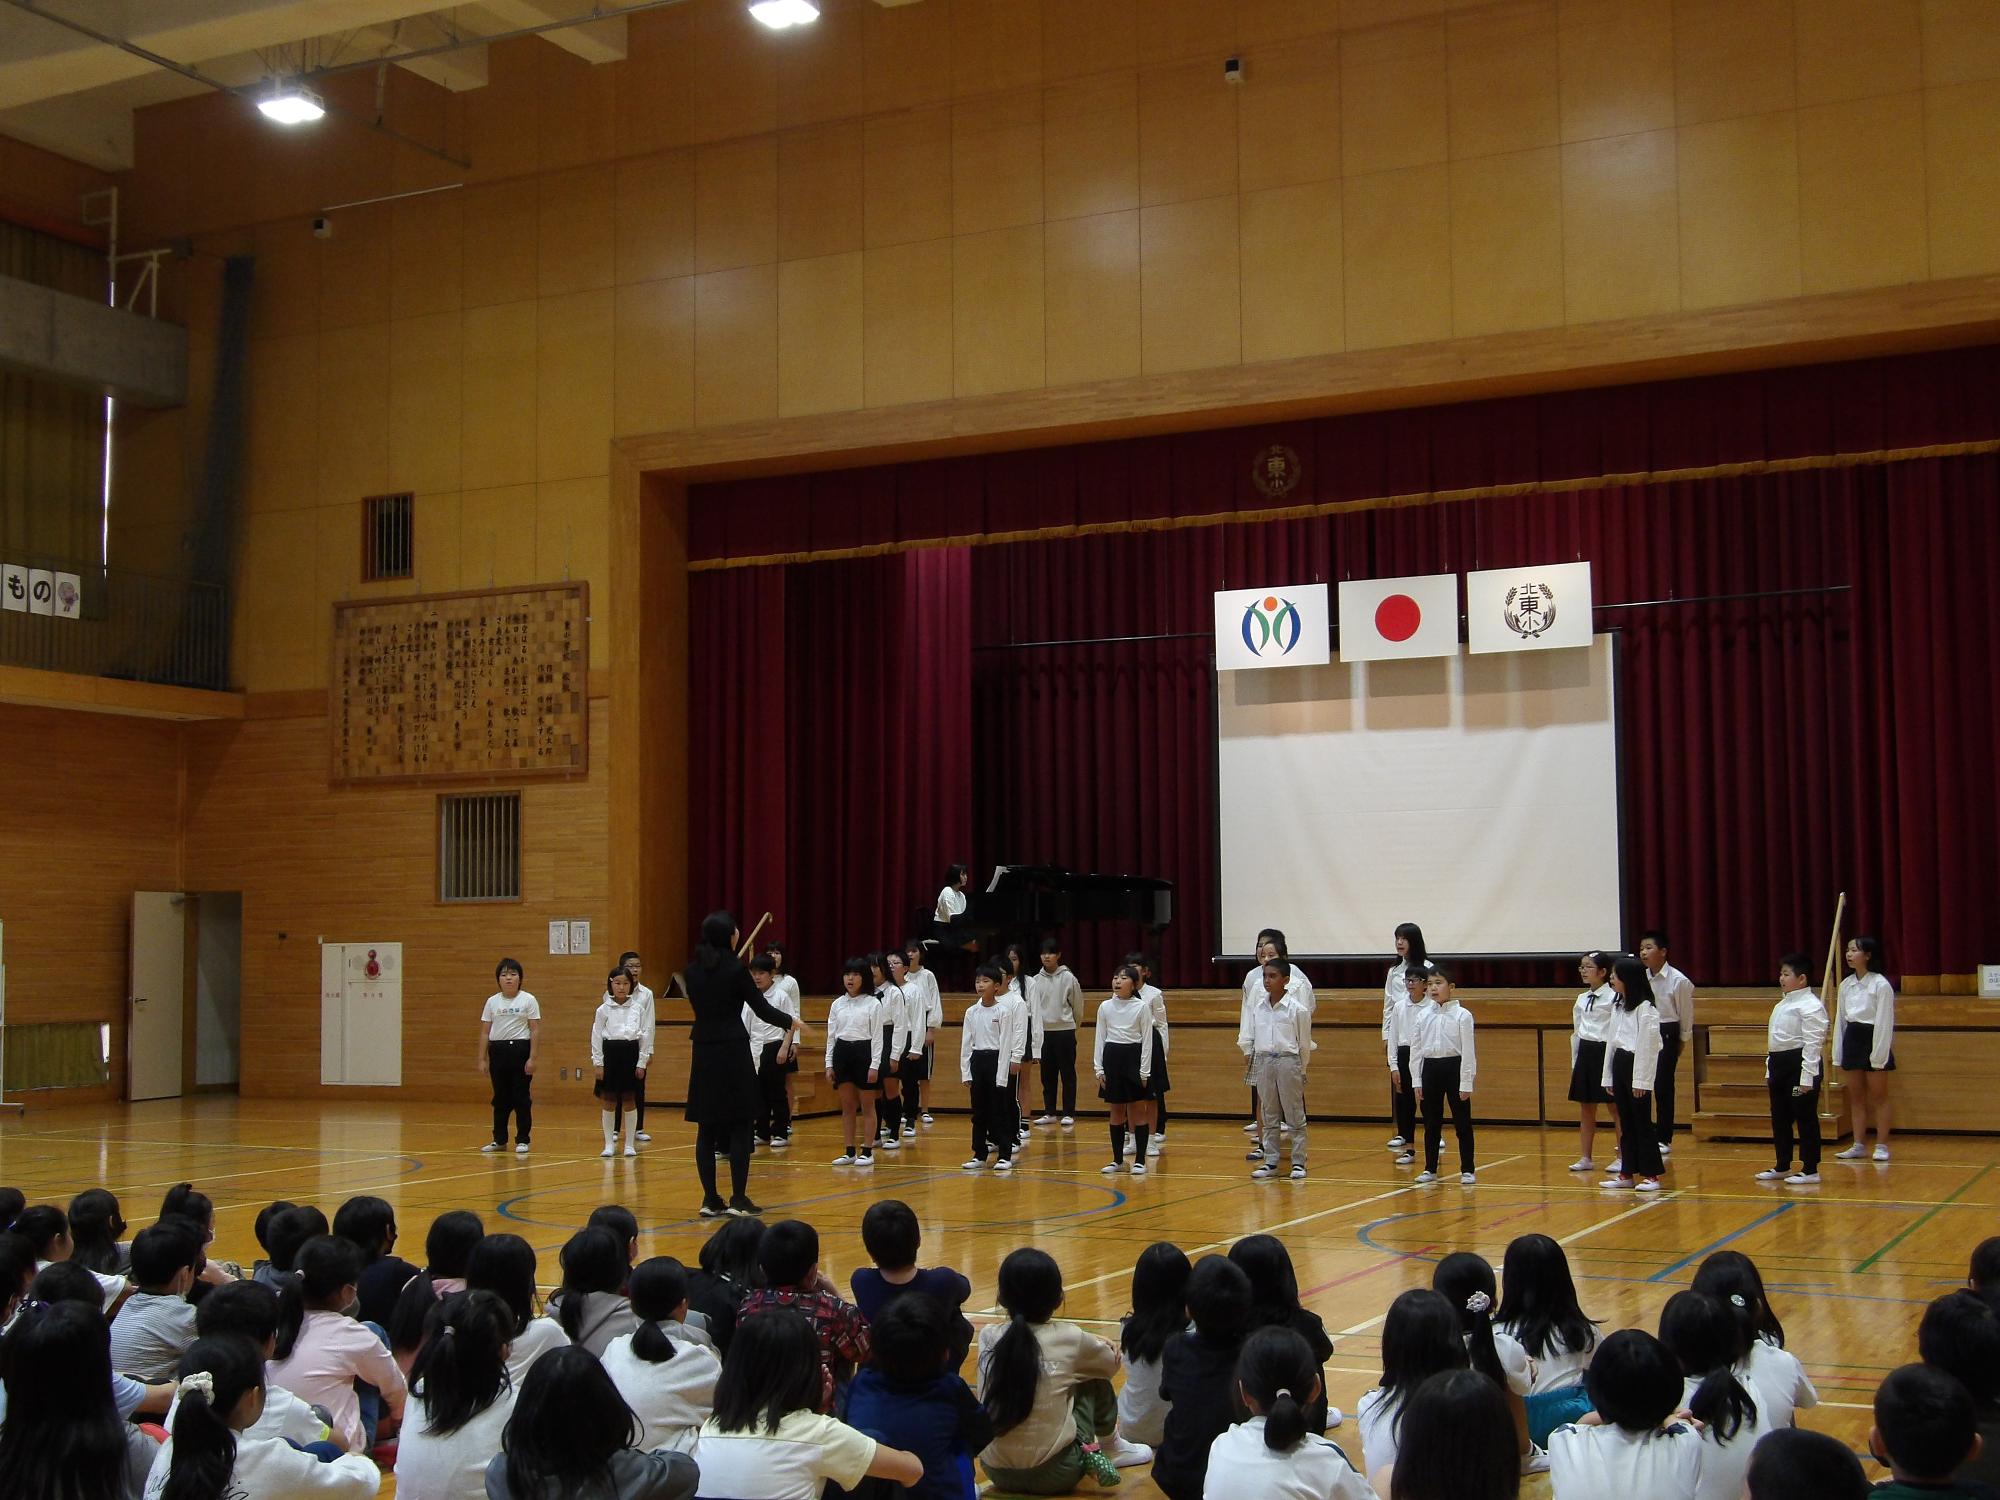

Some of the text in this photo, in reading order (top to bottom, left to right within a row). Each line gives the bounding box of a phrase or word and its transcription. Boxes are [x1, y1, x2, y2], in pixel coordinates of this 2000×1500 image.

[7, 574, 52, 603] もの
[1519, 583, 1542, 631] 北東小
